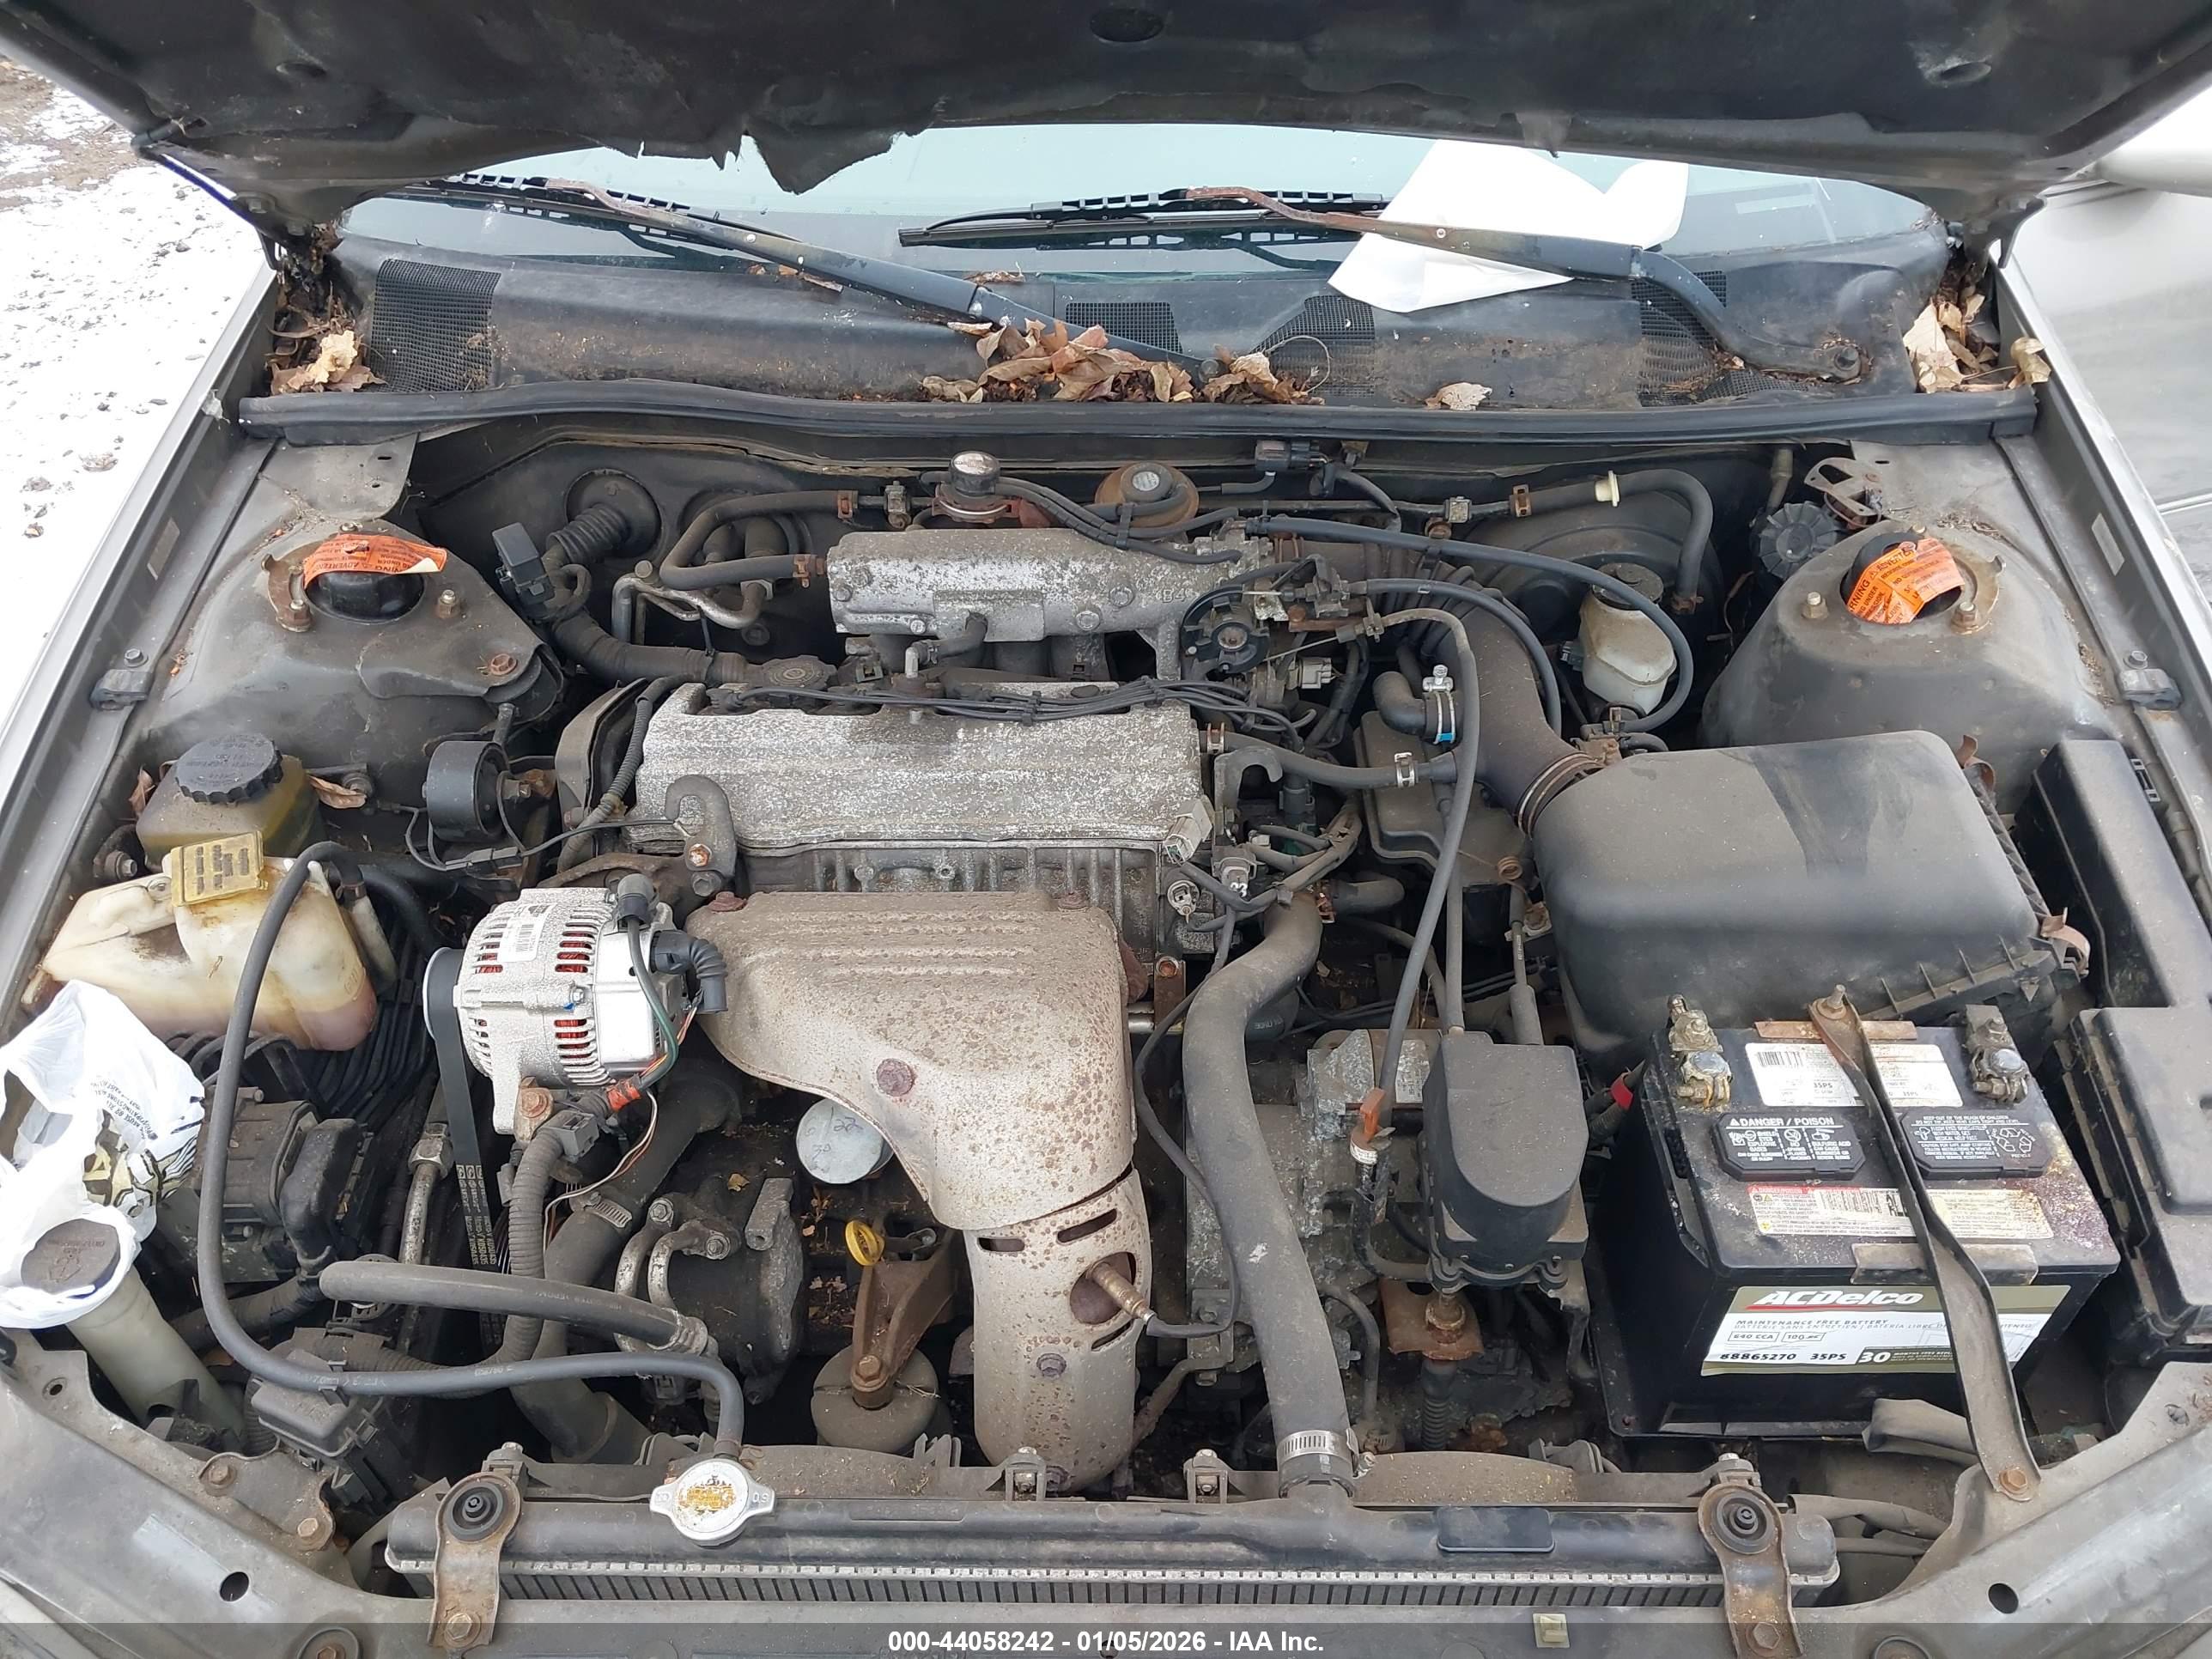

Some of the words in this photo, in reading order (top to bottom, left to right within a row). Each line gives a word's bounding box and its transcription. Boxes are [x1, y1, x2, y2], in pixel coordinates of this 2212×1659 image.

[1740, 1118, 1784, 1127] DANGER
[1794, 1117, 1834, 1126] POISON
[1753, 1291, 1923, 1305] ACDelco
[1858, 1352, 1892, 1363] 30
